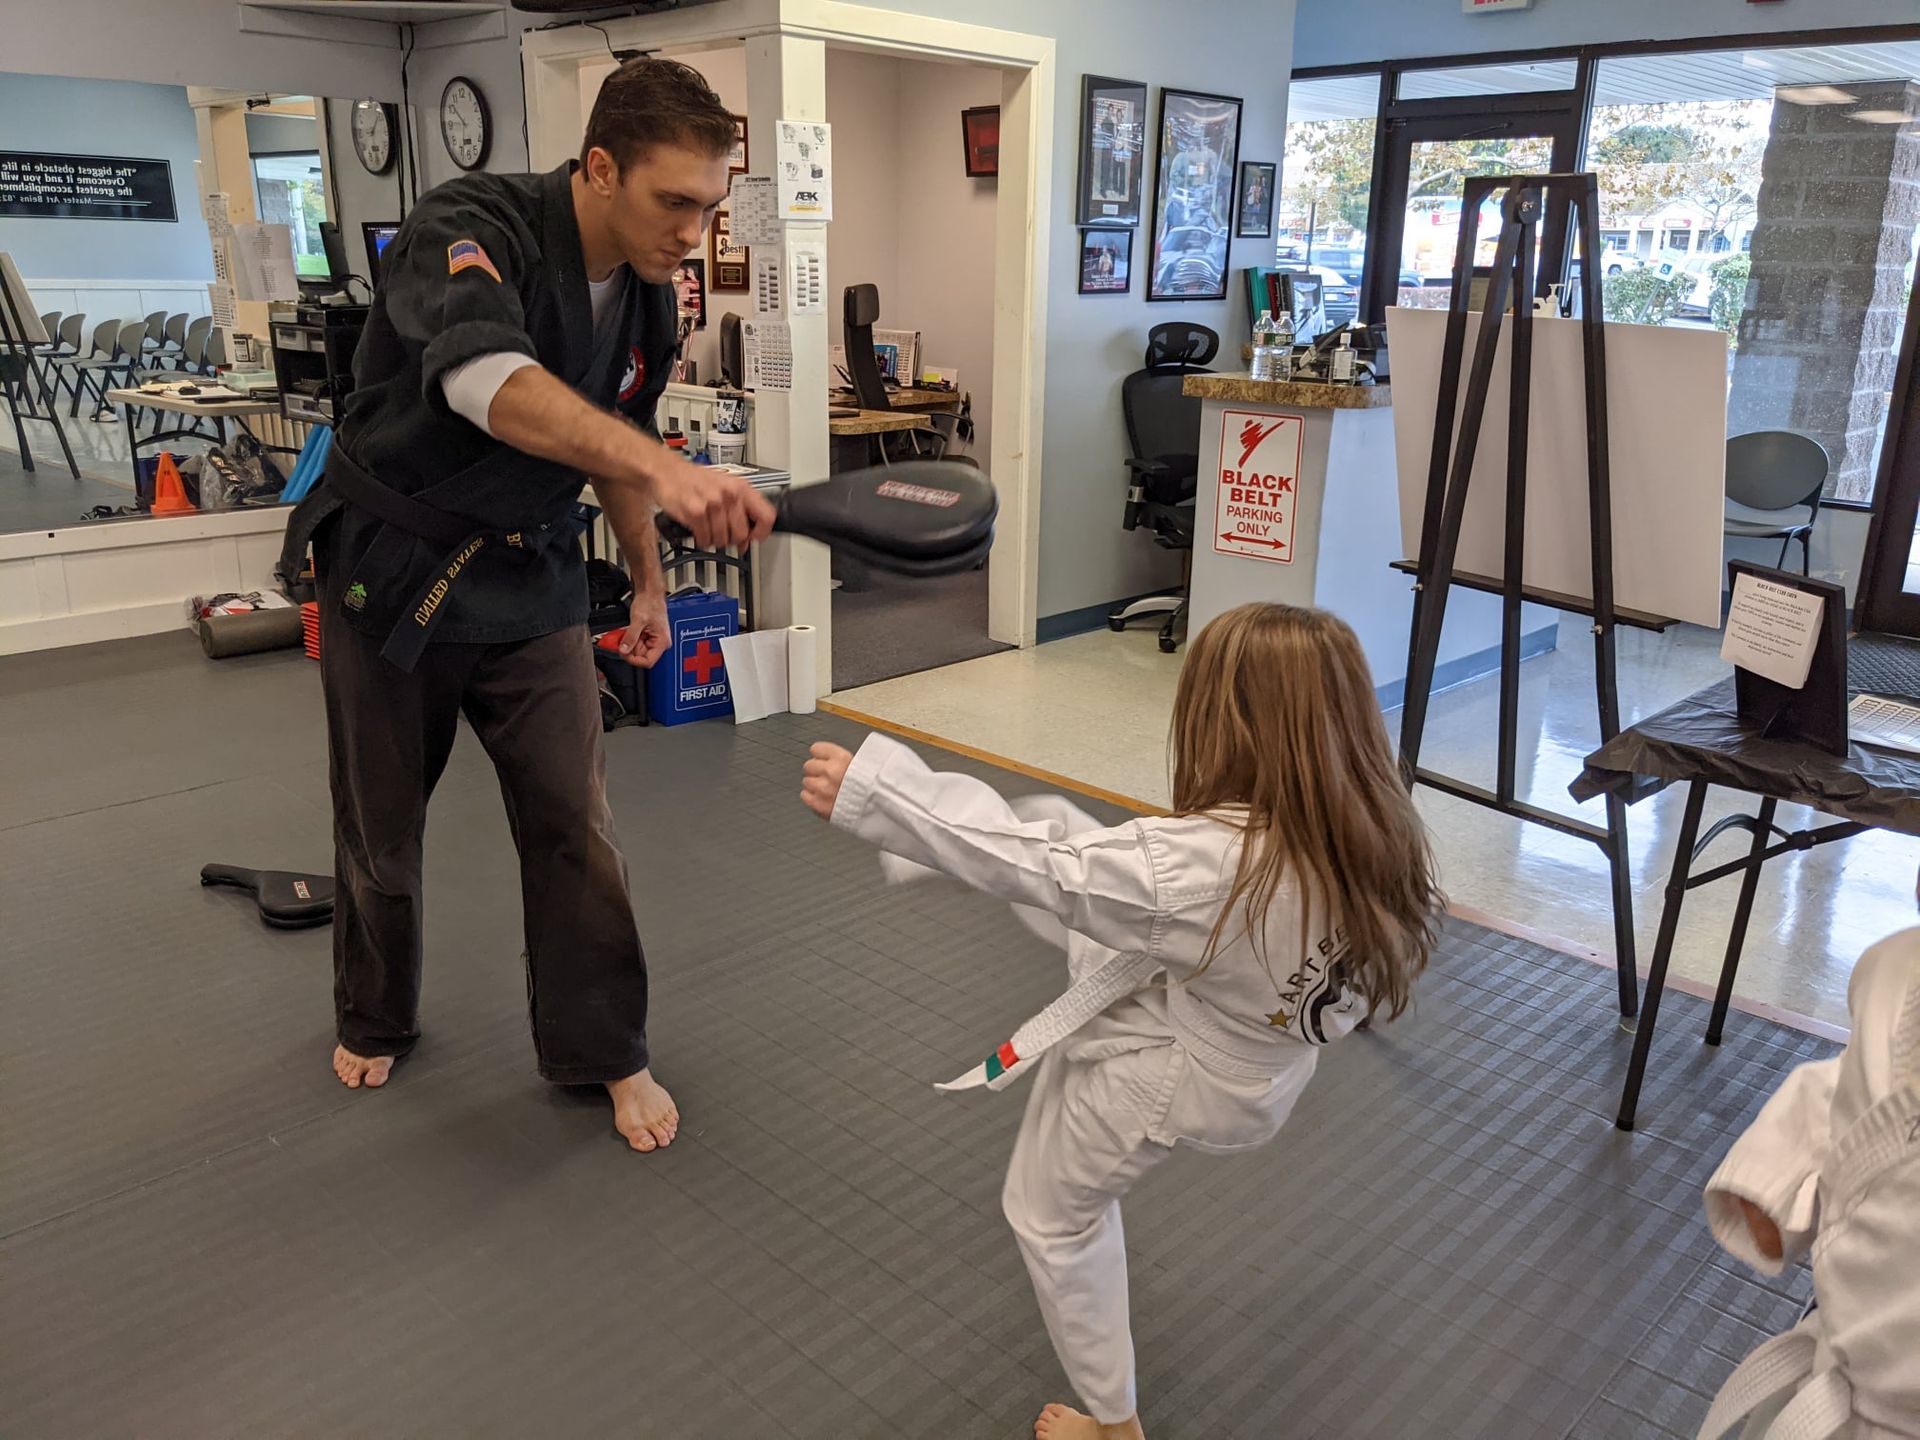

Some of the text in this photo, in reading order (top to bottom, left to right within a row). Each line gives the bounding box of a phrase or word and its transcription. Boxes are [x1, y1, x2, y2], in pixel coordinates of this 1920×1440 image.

[1222, 469, 1293, 492] BLACK
[1230, 488, 1282, 507] BELT
[1226, 505, 1283, 523] PARKING
[1236, 521, 1270, 537] ONLY
[680, 684, 726, 702] FIRST AID
[1279, 957, 1321, 1004] ART
